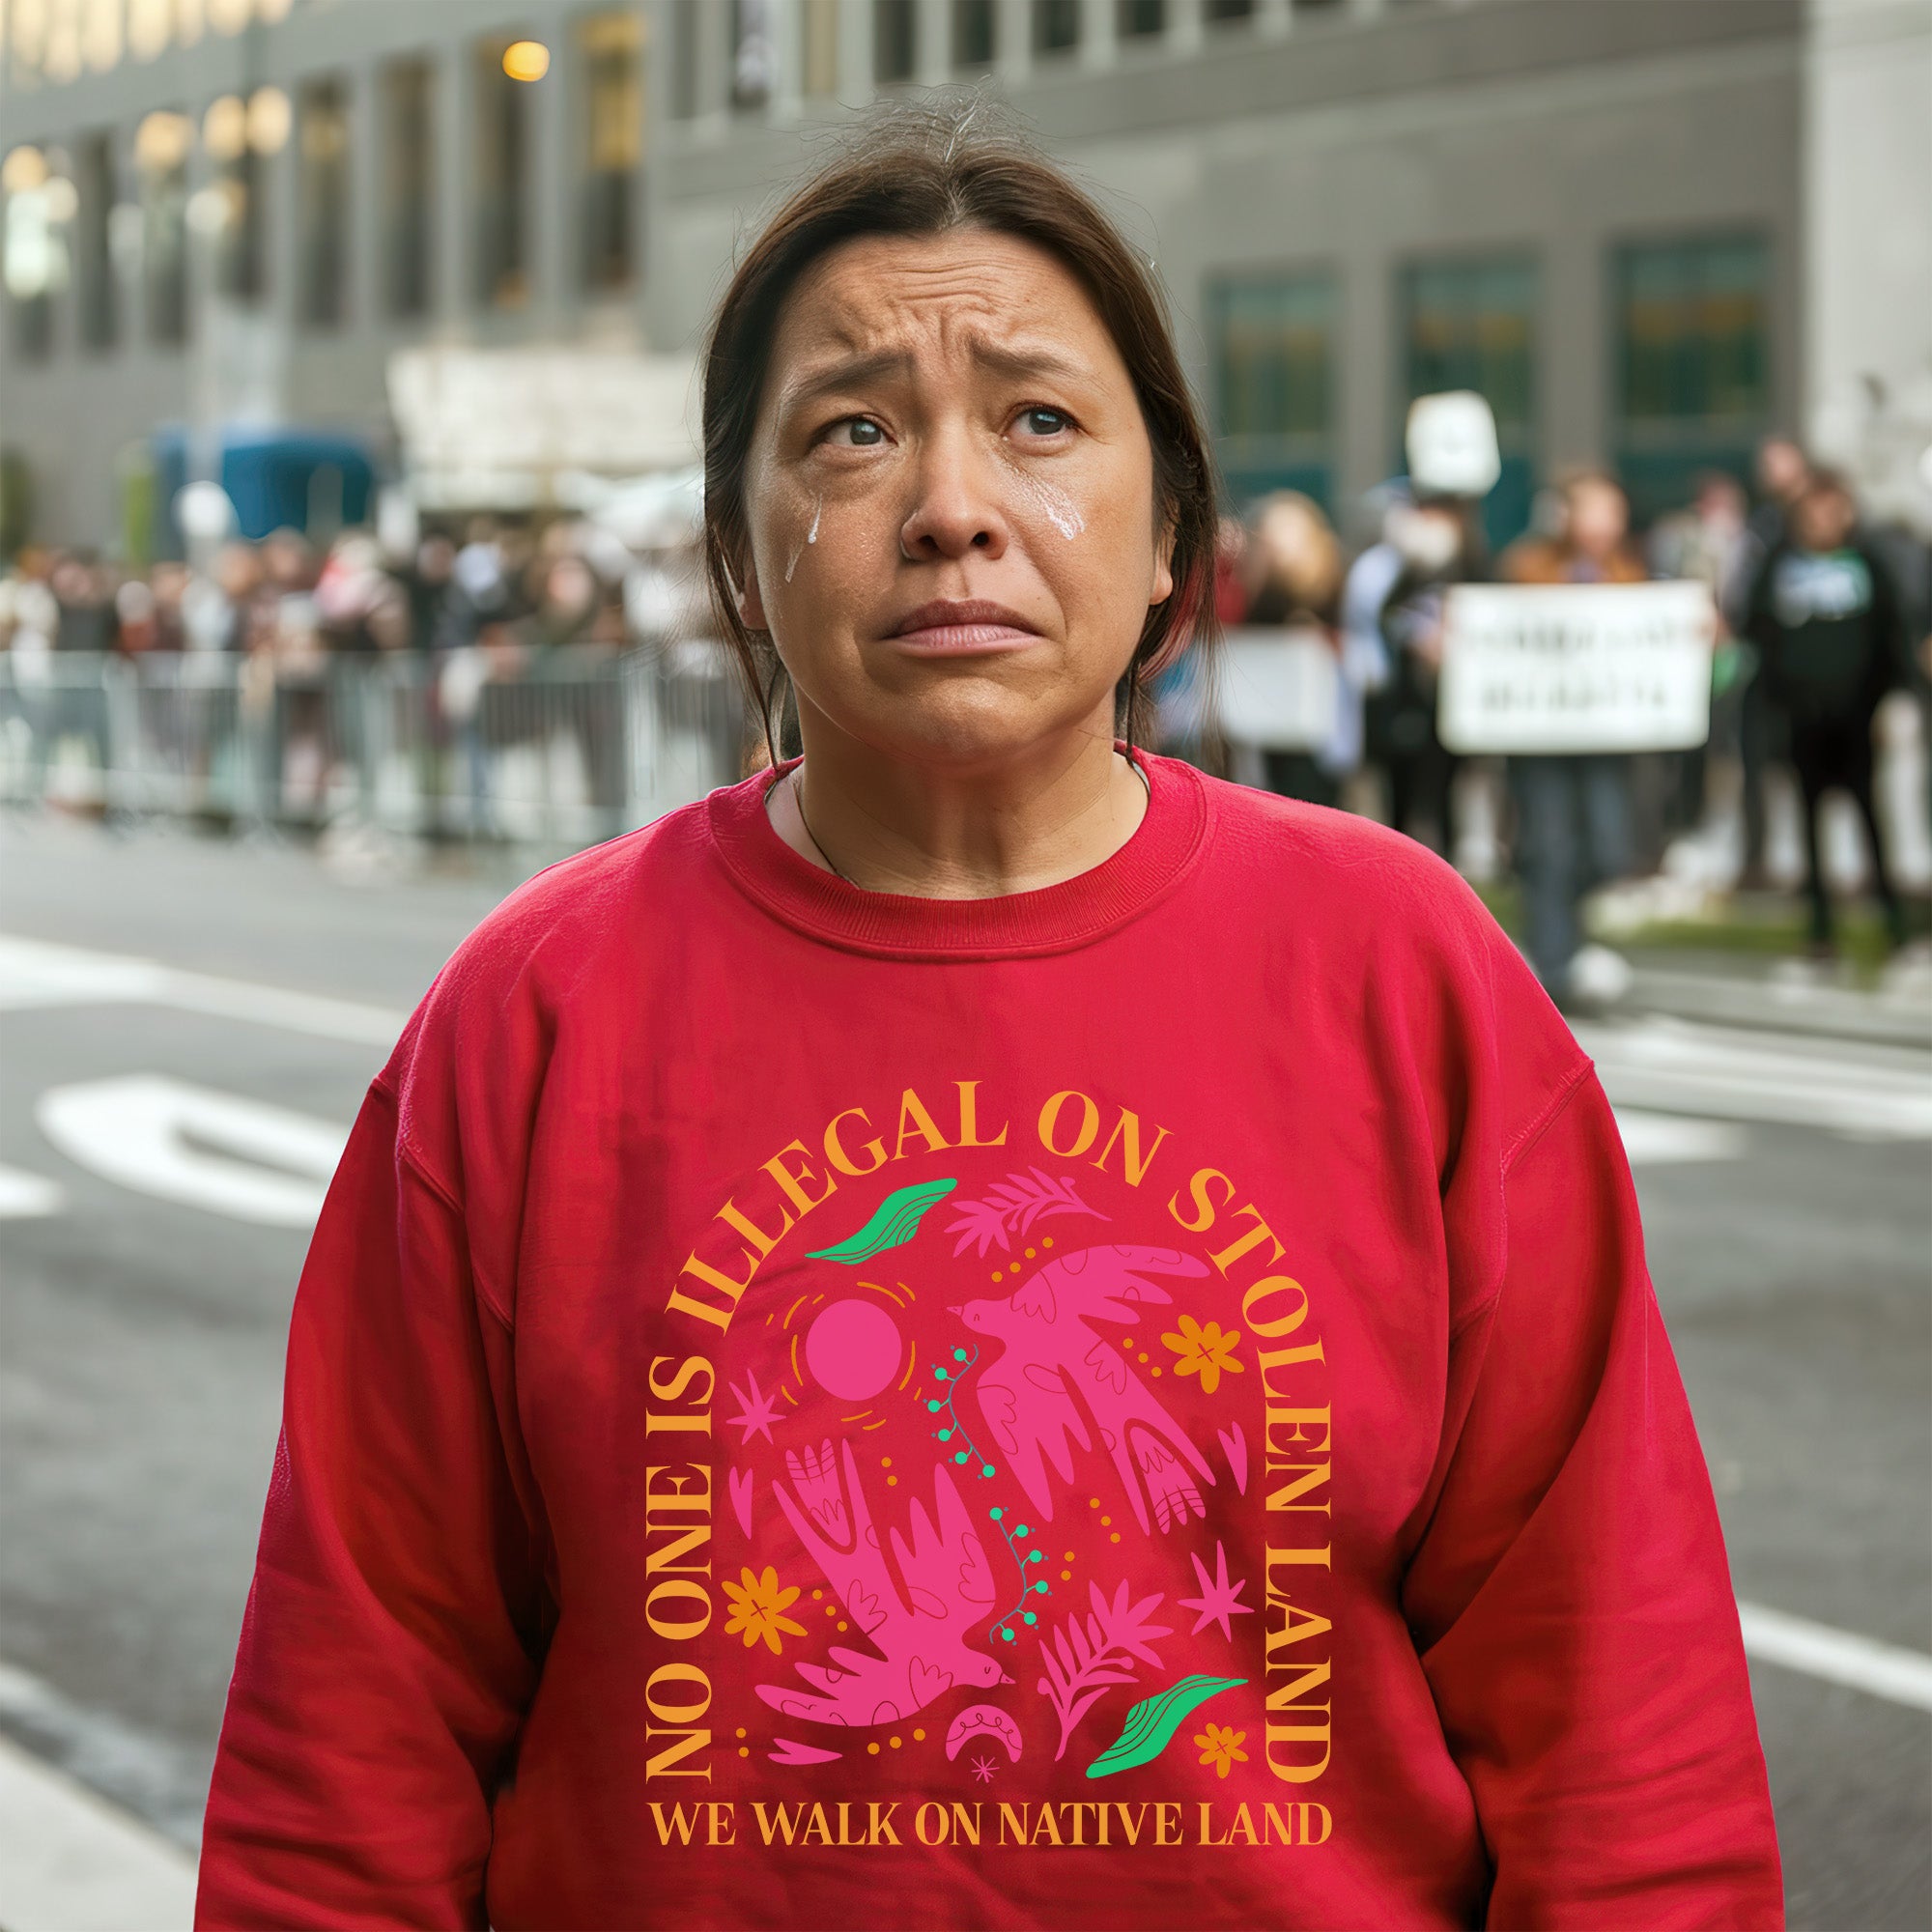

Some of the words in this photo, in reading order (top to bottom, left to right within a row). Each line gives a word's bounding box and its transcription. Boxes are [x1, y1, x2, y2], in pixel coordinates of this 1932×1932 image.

[665, 1080, 1009, 1337] ILLEGAL
[1037, 1090, 1176, 1188] ON
[645, 1354, 717, 1441] IS
[1168, 1167, 1332, 1520] STOLEN
[644, 1462, 713, 1641] ONE
[644, 1662, 713, 1784] NO
[1264, 1541, 1333, 1784] LAND
[646, 1802, 737, 1847] WE
[750, 1802, 902, 1847] WALK
[915, 1802, 982, 1847] ON
[998, 1802, 1185, 1847] NATIVE
[1197, 1802, 1334, 1847] LAND
